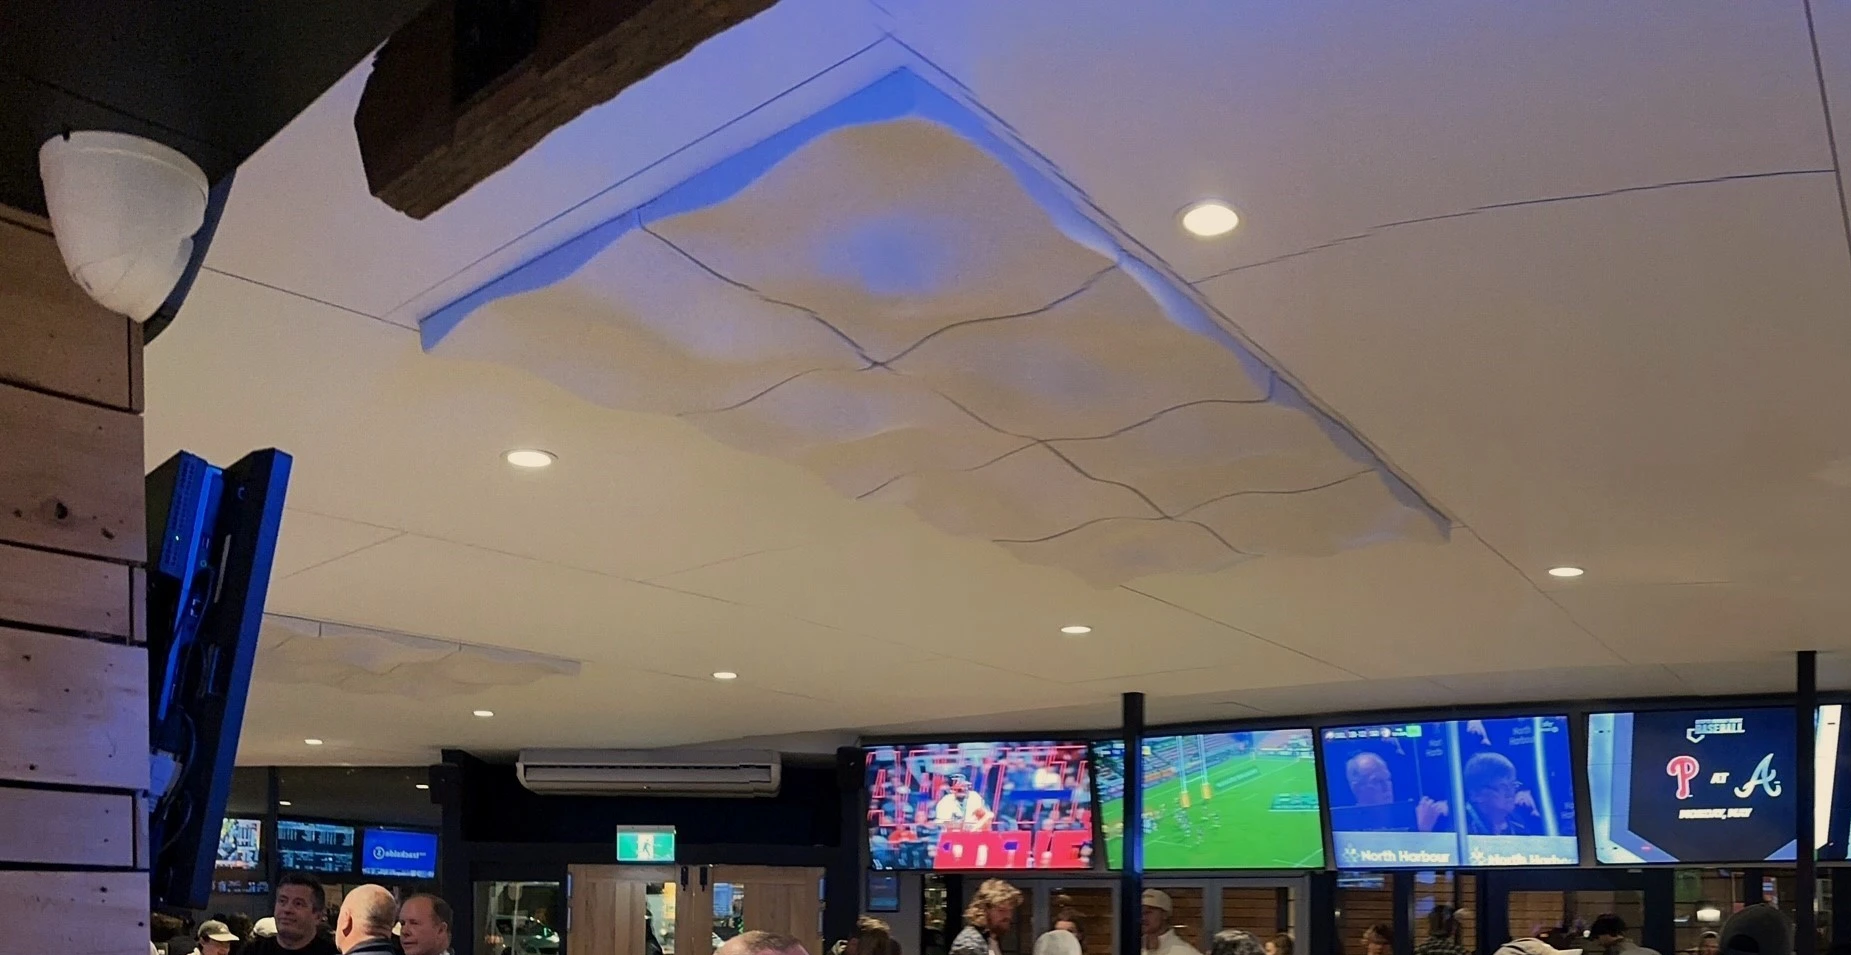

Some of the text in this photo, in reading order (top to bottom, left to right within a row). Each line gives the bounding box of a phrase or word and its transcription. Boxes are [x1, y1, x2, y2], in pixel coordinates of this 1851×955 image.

[1695, 721, 1745, 734] BASEBALL
[1361, 850, 1449, 863] North Harbour
